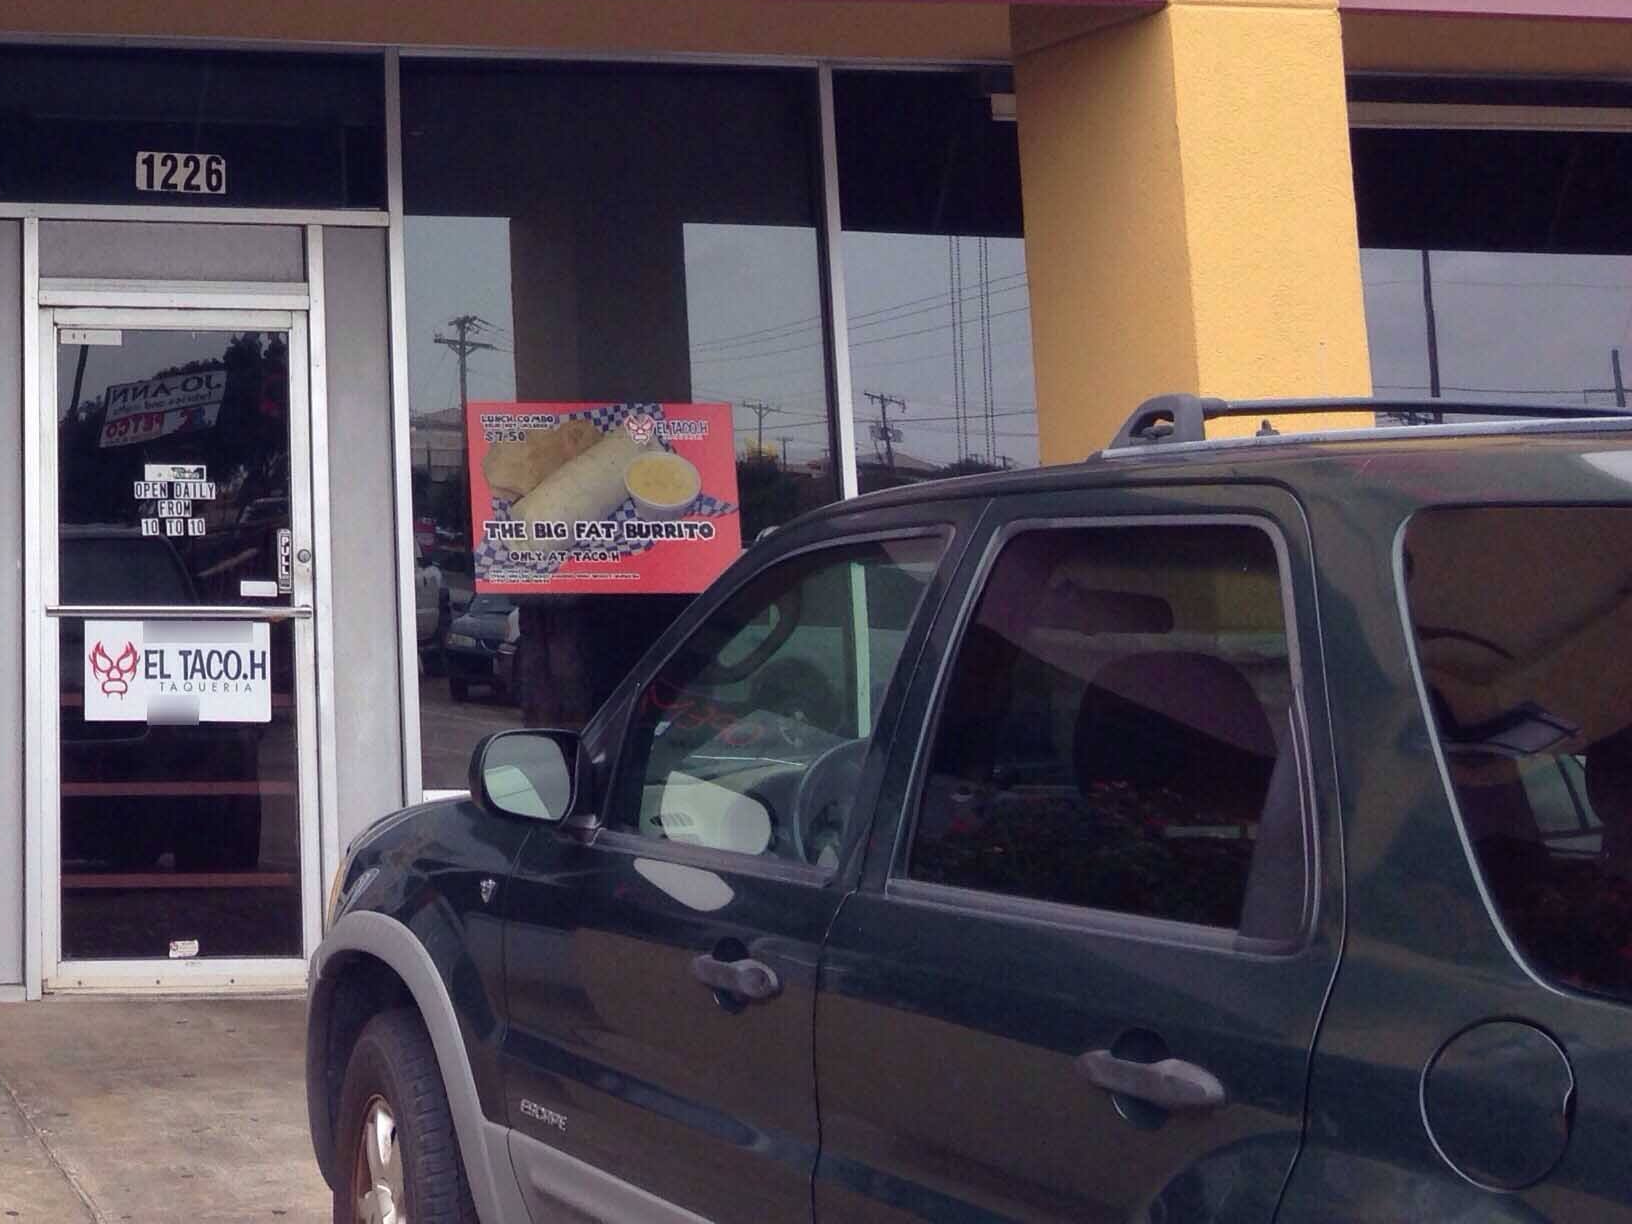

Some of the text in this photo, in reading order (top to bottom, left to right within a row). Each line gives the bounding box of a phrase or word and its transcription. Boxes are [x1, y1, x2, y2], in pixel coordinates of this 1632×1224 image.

[141, 153, 224, 192] 1226
[517, 414, 554, 423] COMBO
[655, 420, 670, 434] EL
[135, 482, 214, 498] OPEN DAILY
[159, 501, 191, 516] FROM
[144, 519, 204, 535] 10 TO 10
[483, 522, 716, 540] THE BIG FAT BURRITO
[281, 536, 290, 575] PULL
[510, 551, 543, 561] ONLY
[548, 551, 566, 561] AT
[144, 649, 267, 681] EL TACO.H
[159, 681, 252, 693] TAQUERIA
[520, 1099, 569, 1131] ESCAPE
